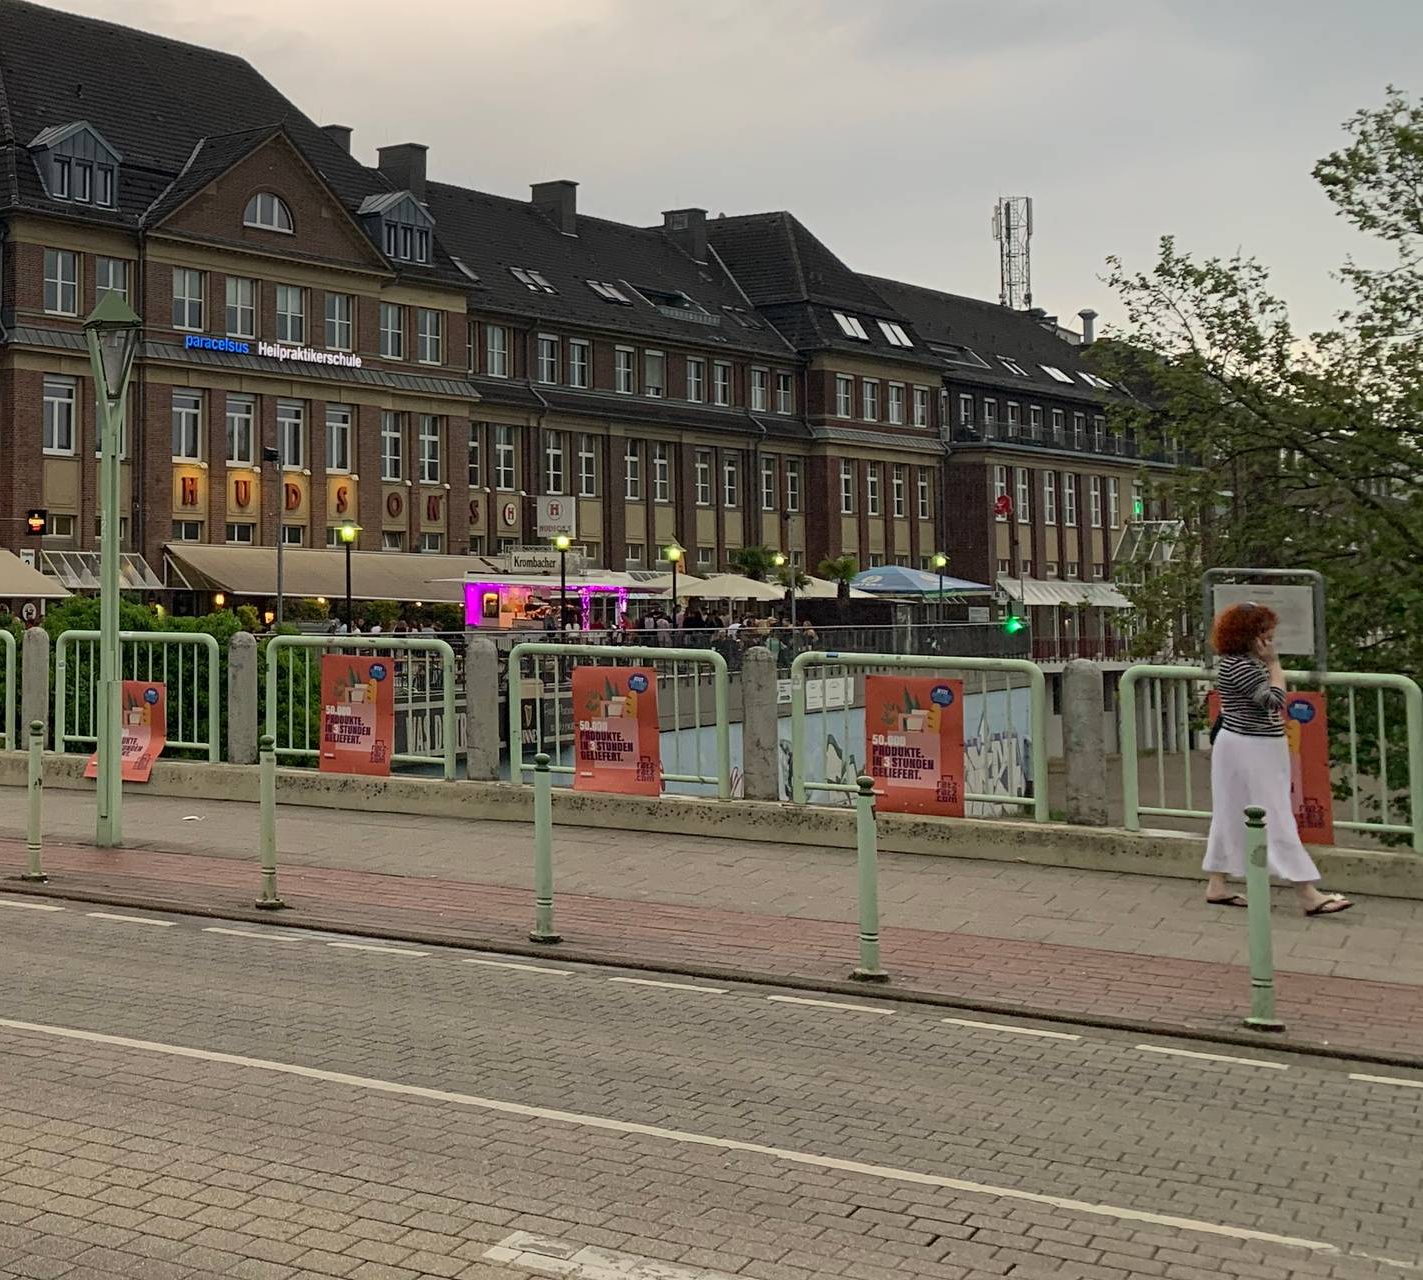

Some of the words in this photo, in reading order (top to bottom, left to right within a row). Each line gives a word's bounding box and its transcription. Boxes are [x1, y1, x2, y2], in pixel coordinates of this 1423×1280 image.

[185, 335, 249, 354] paracelsus
[258, 341, 362, 368] Heilpraktikerschule
[514, 555, 556, 569] Krombacher
[339, 725, 371, 736] STUNDEN
[580, 731, 625, 742] PRODUKTE.
[872, 734, 906, 746] 50.000
[589, 741, 595, 752] 3
[597, 742, 634, 753] STUNDEN
[872, 745, 924, 758] PRODUKTE.
[581, 751, 624, 762] GELIEFERT.
[872, 757, 882, 767] IN
[883, 757, 890, 768] 3
[892, 758, 935, 770] STUNDEN
[872, 767, 922, 780] GELIEFERT.
